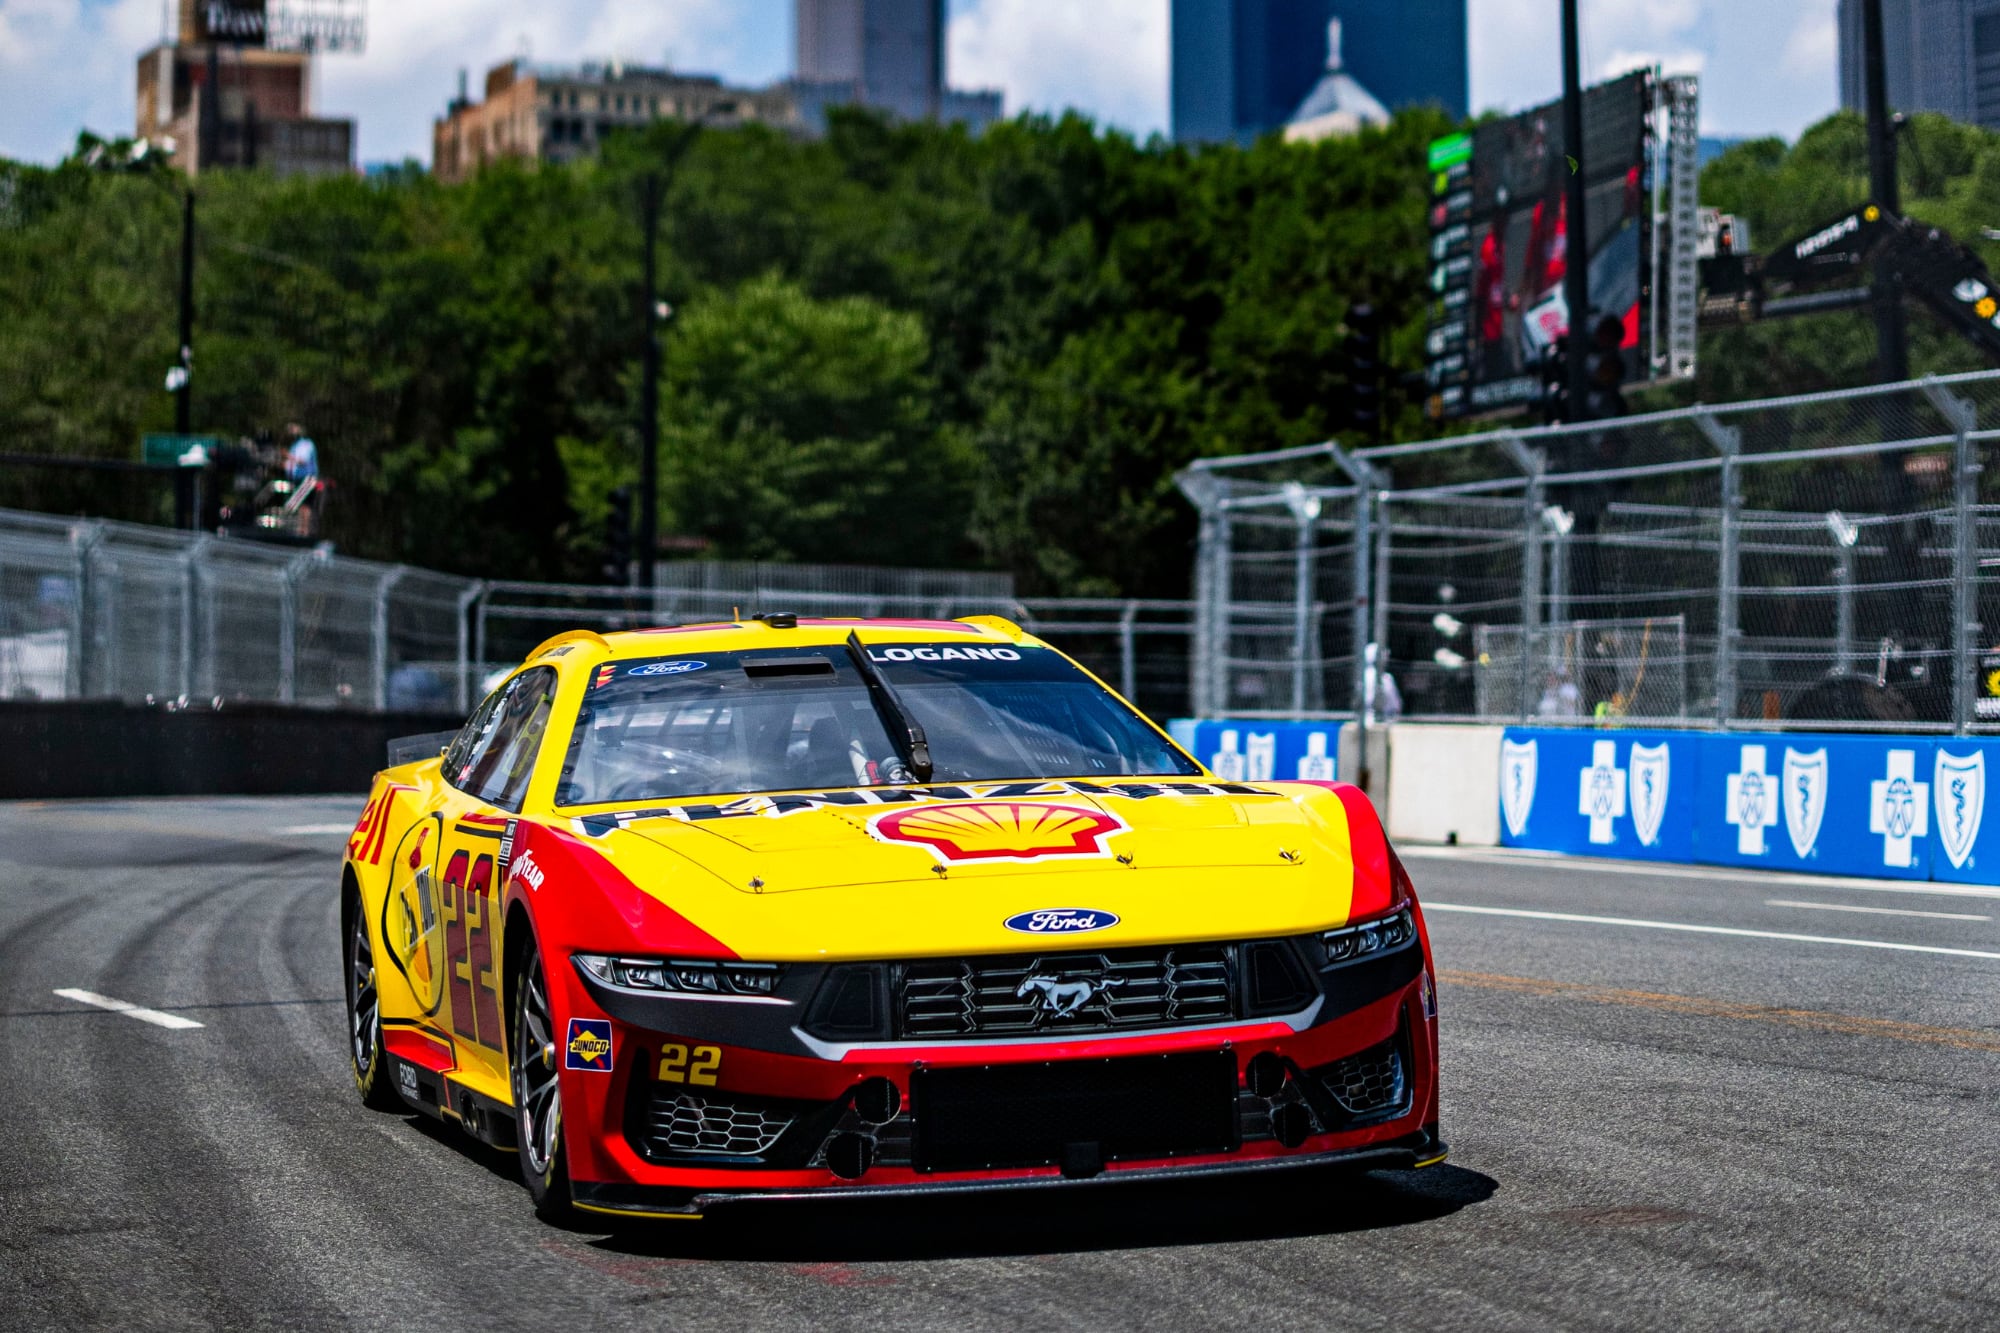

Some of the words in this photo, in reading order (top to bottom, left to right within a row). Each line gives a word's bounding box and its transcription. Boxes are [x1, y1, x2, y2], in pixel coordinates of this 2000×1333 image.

[867, 648, 1021, 662] LOGANO
[643, 662, 692, 674] Ford
[510, 852, 545, 892] YEAR
[1028, 911, 1097, 931] Ford
[443, 848, 504, 1054] 22
[572, 1040, 608, 1053] SUNOCO
[399, 1063, 417, 1088] FORD
[658, 1043, 722, 1087] 22
